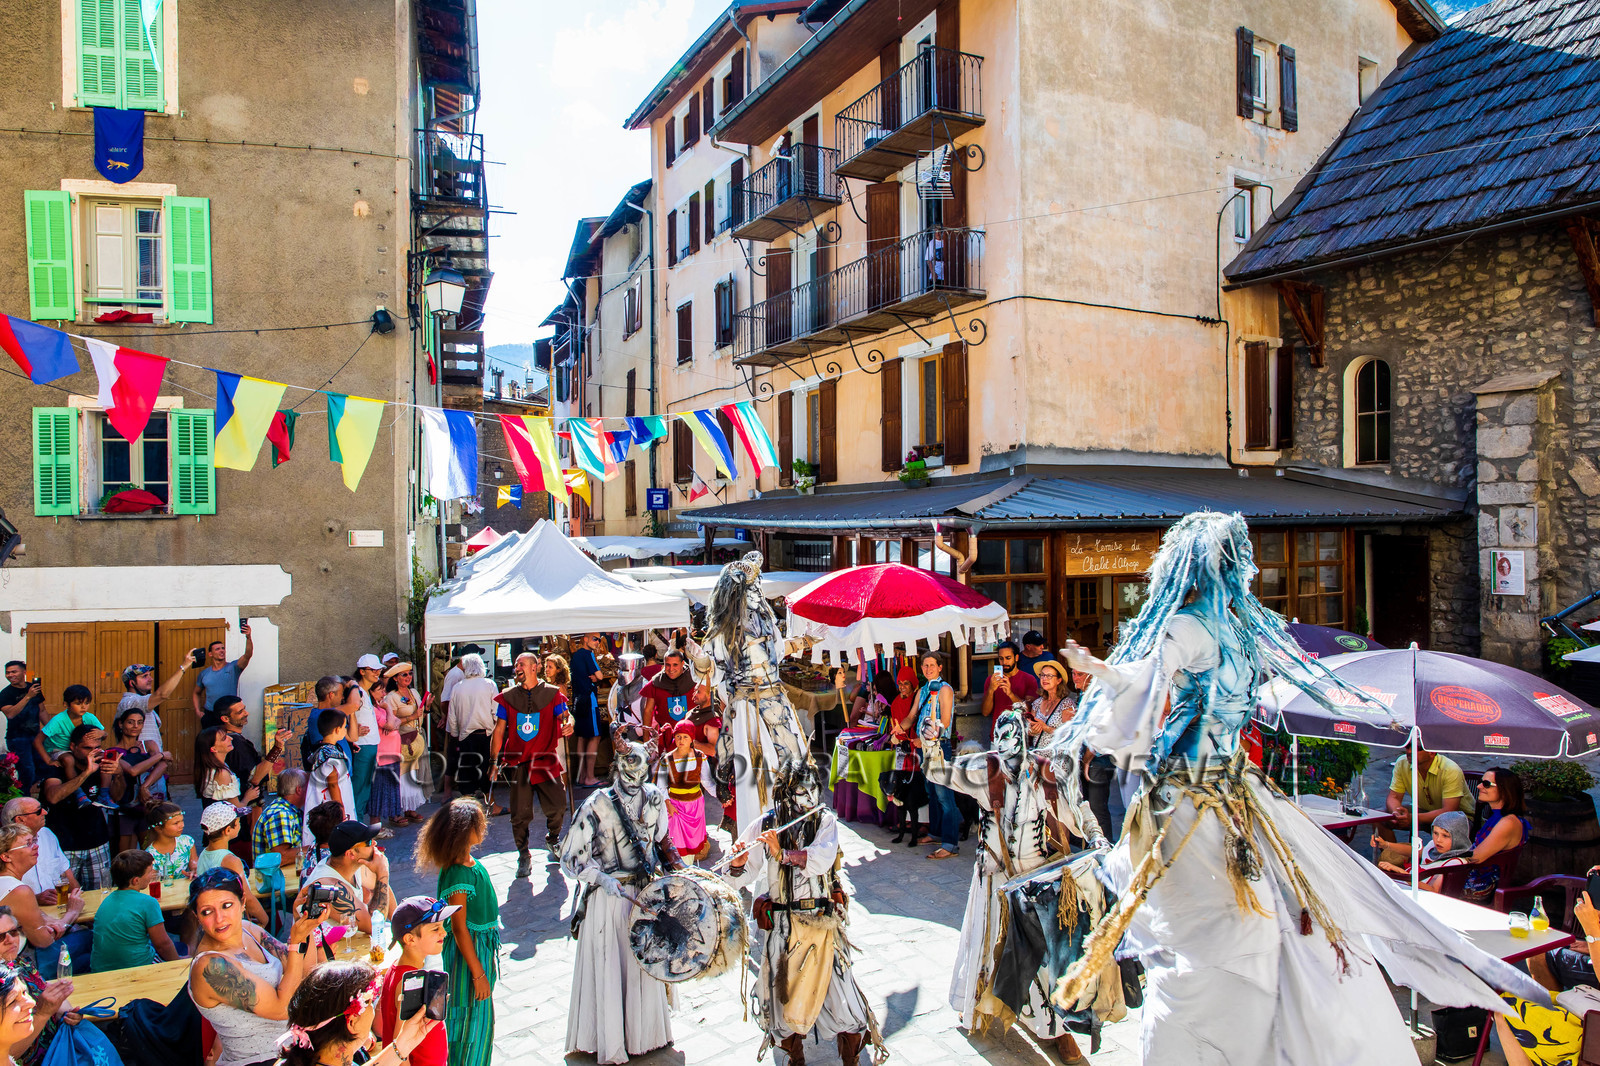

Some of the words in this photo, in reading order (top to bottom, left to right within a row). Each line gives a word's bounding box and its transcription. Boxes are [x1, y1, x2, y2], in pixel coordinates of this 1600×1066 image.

[1070, 535, 1083, 554] La
[1131, 539, 1141, 551] du
[1082, 556, 1110, 572] Chalet
[1111, 555, 1140, 571] d'Alpage
[400, 622, 406, 631] 6
[1437, 694, 1494, 714] DESPERADOS
